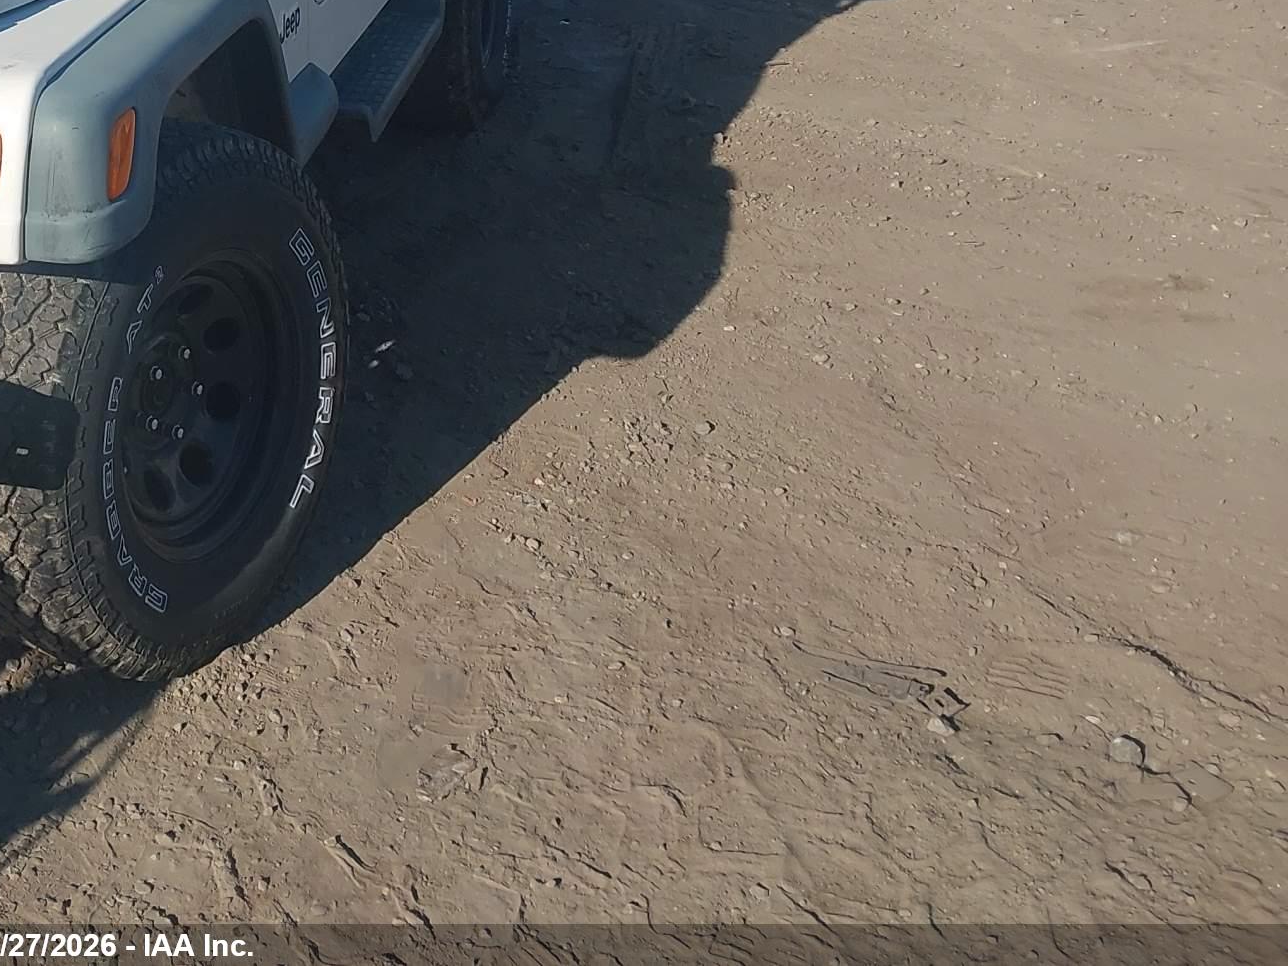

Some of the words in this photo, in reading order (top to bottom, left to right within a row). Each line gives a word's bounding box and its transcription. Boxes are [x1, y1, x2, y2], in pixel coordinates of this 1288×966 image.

[280, 7, 300, 44] Jeep
[289, 227, 337, 509] GENERAL
[103, 377, 168, 613] GRABBER
